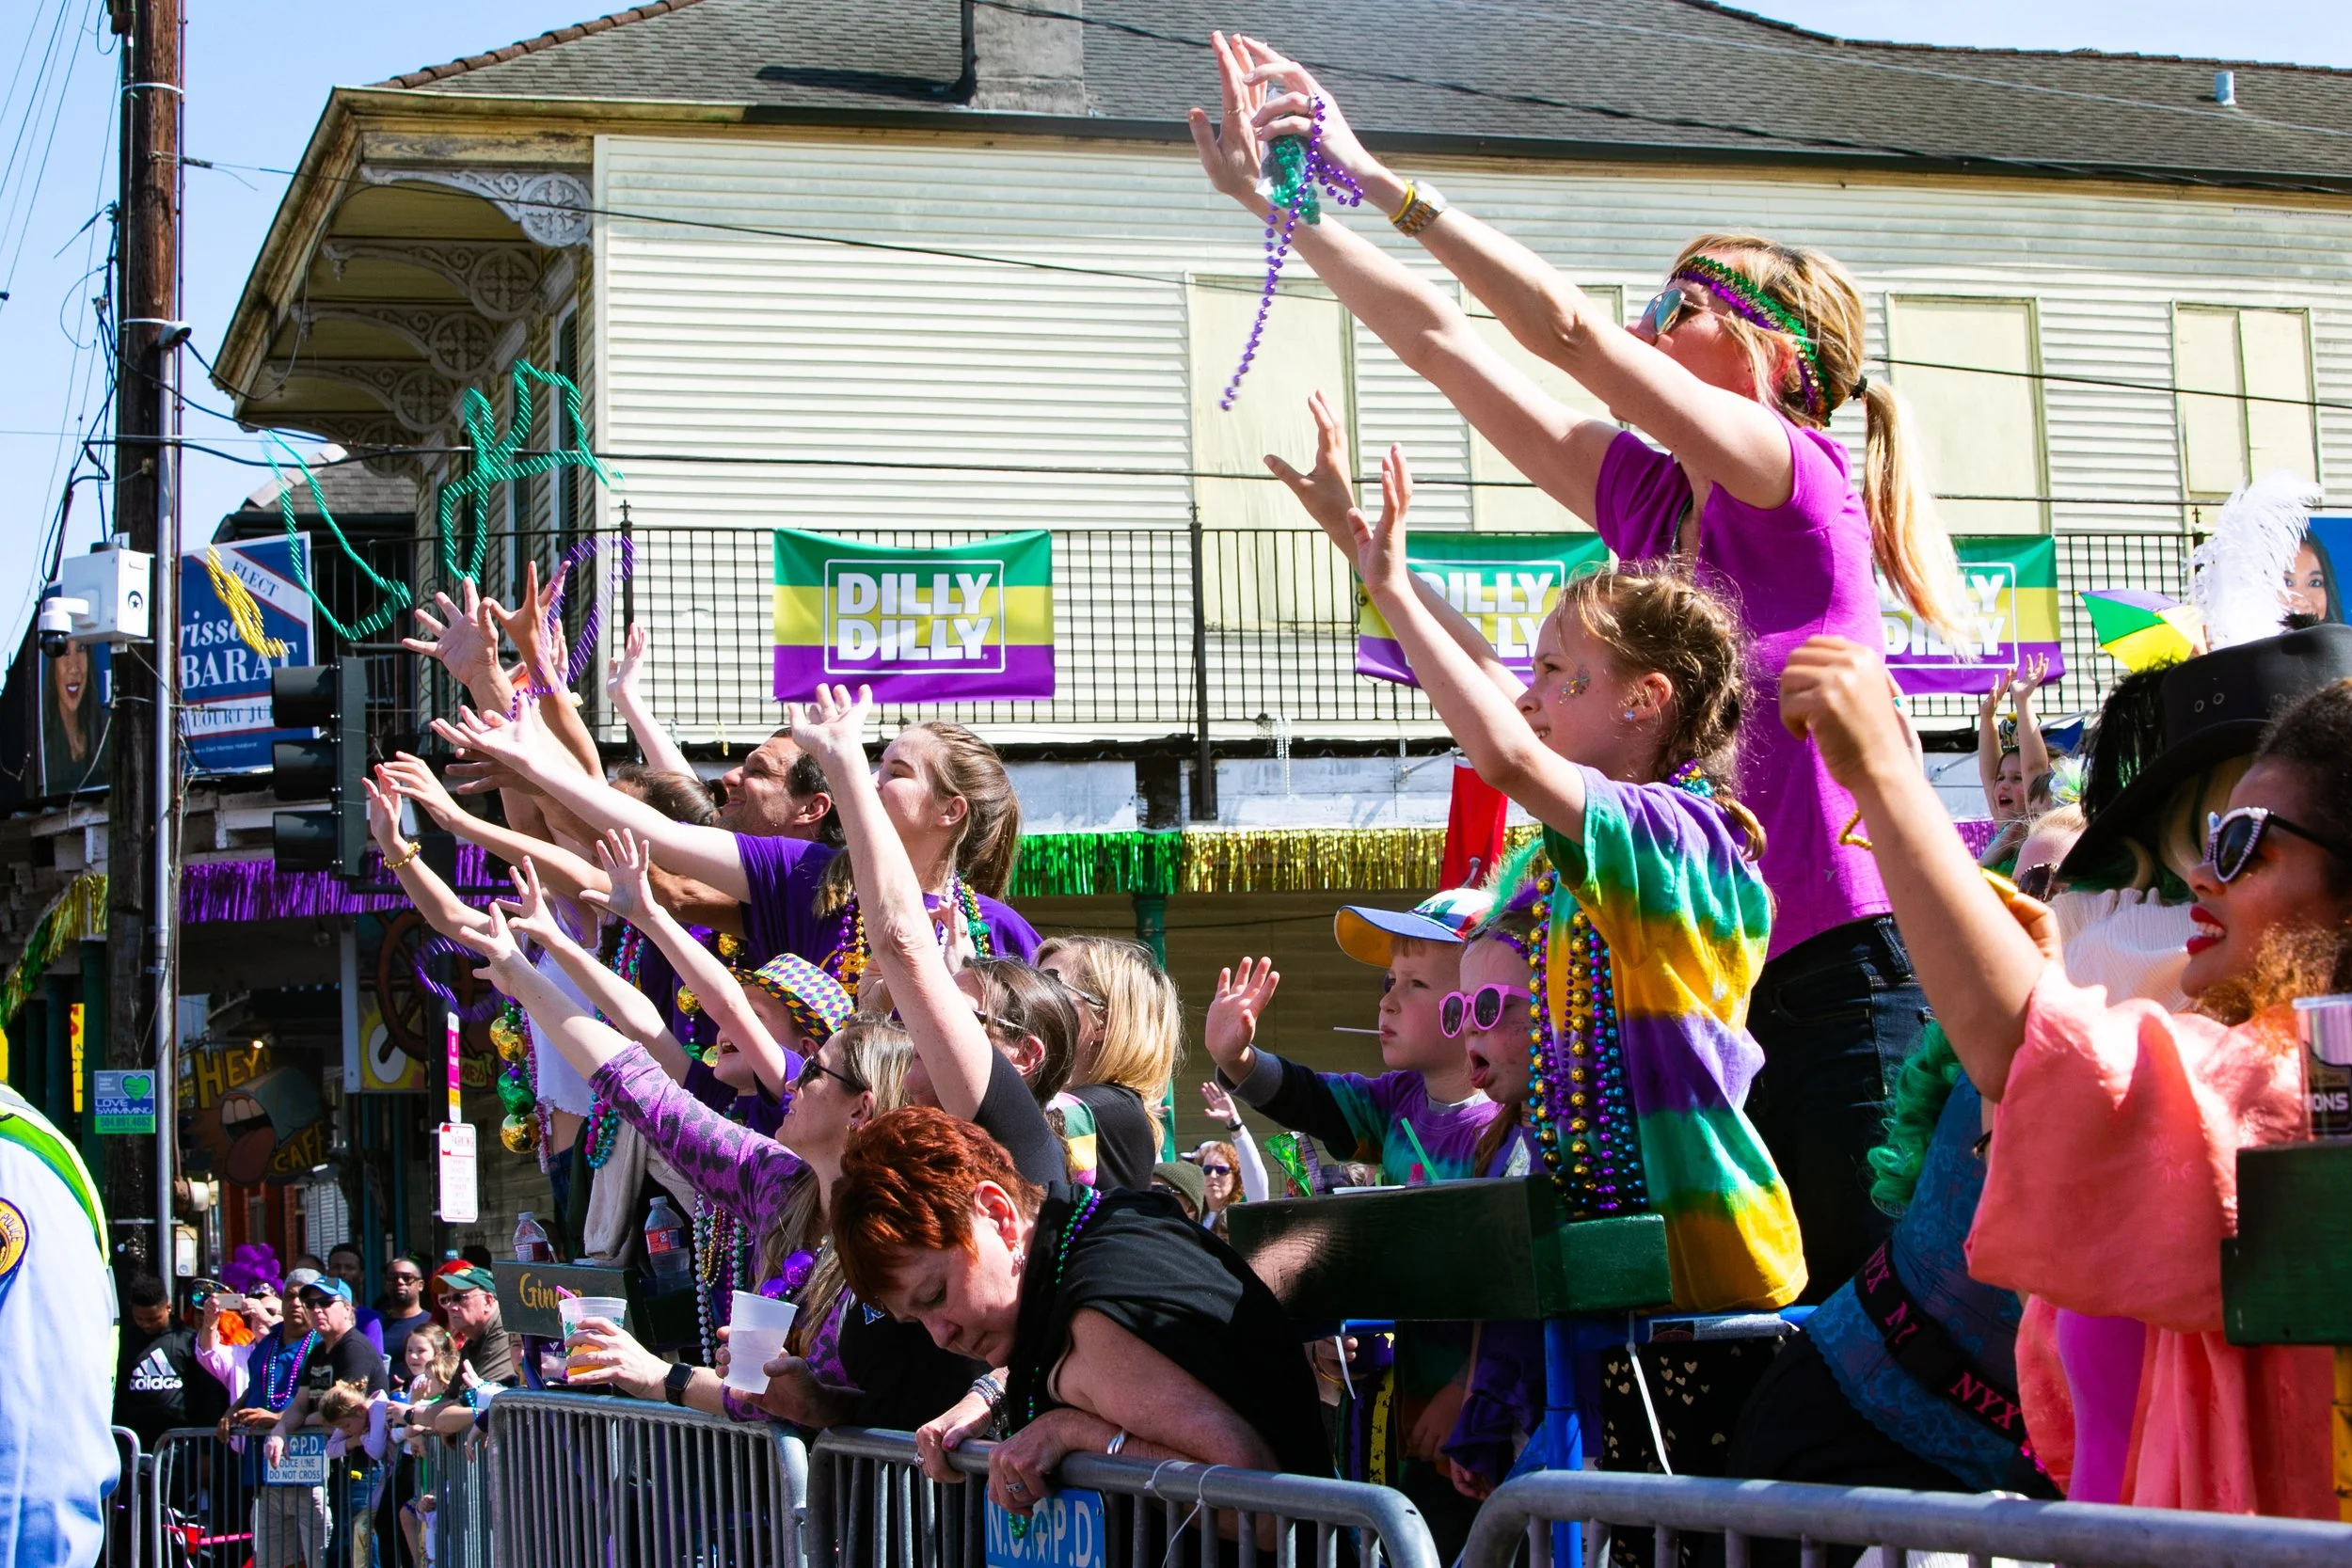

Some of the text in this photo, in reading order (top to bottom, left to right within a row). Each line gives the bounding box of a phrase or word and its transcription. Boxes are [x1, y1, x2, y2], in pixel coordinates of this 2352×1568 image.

[231, 562, 279, 597] ELECT
[837, 573, 993, 615] DILLY
[195, 1047, 271, 1109] HEY!
[95, 1099, 128, 1107] LOVE
[1949, 1371, 2023, 1430] NYX
[269, 1470, 320, 1480] DO NOT CROSS
[279, 1458, 315, 1467] OLICE LINE
